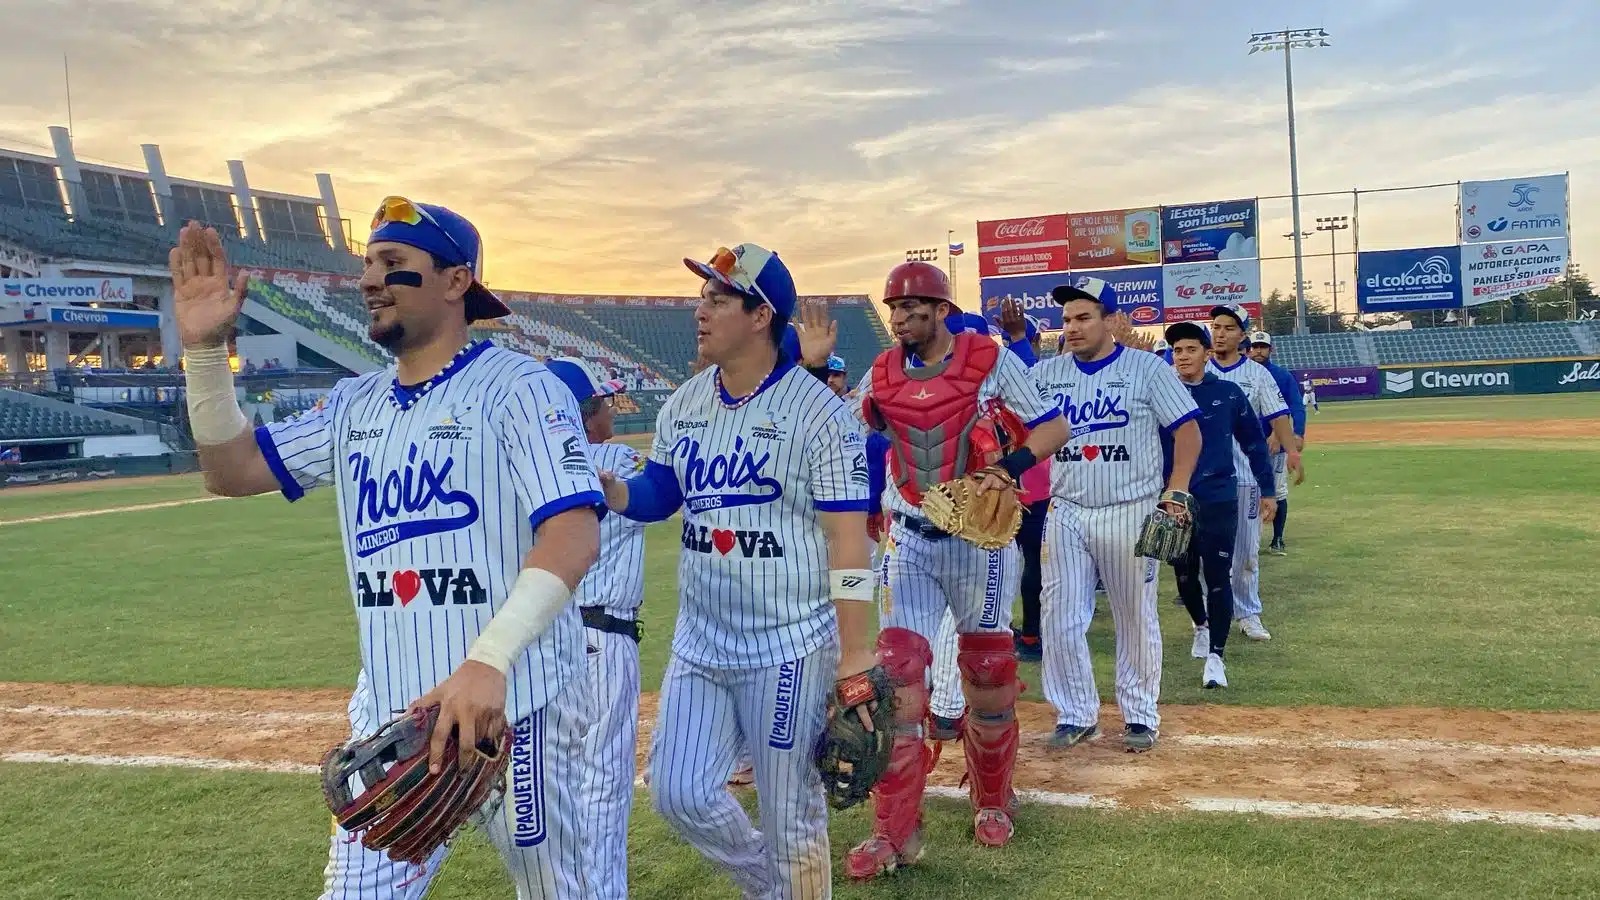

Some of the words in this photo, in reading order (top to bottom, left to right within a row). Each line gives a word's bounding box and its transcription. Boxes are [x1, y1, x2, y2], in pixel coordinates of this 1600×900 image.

[1177, 219, 1200, 229] son
[1201, 208, 1251, 225] huevos!
[1511, 218, 1561, 230] FATIMA
[995, 219, 1048, 239] Coca-Cola
[1088, 246, 1116, 258] Valle
[1501, 243, 1550, 255] GAPA
[1019, 254, 1034, 263] PARA
[1468, 255, 1562, 271] MOTOREFACCIONES
[1366, 273, 1380, 288] el
[1382, 271, 1453, 287] colorado
[1473, 273, 1517, 286] PANELES
[1516, 266, 1561, 280] SOLARES
[24, 283, 96, 297] Chevron
[98, 279, 128, 300] live
[1107, 279, 1157, 293] HERWIN
[1175, 284, 1197, 299] La
[1200, 282, 1248, 295] Perla
[62, 309, 108, 323] Chevron
[1420, 371, 1510, 389] Chevron
[428, 431, 463, 440] CHOIX
[752, 431, 779, 441] CHOIX
[772, 661, 795, 737] PAQUETEXP
